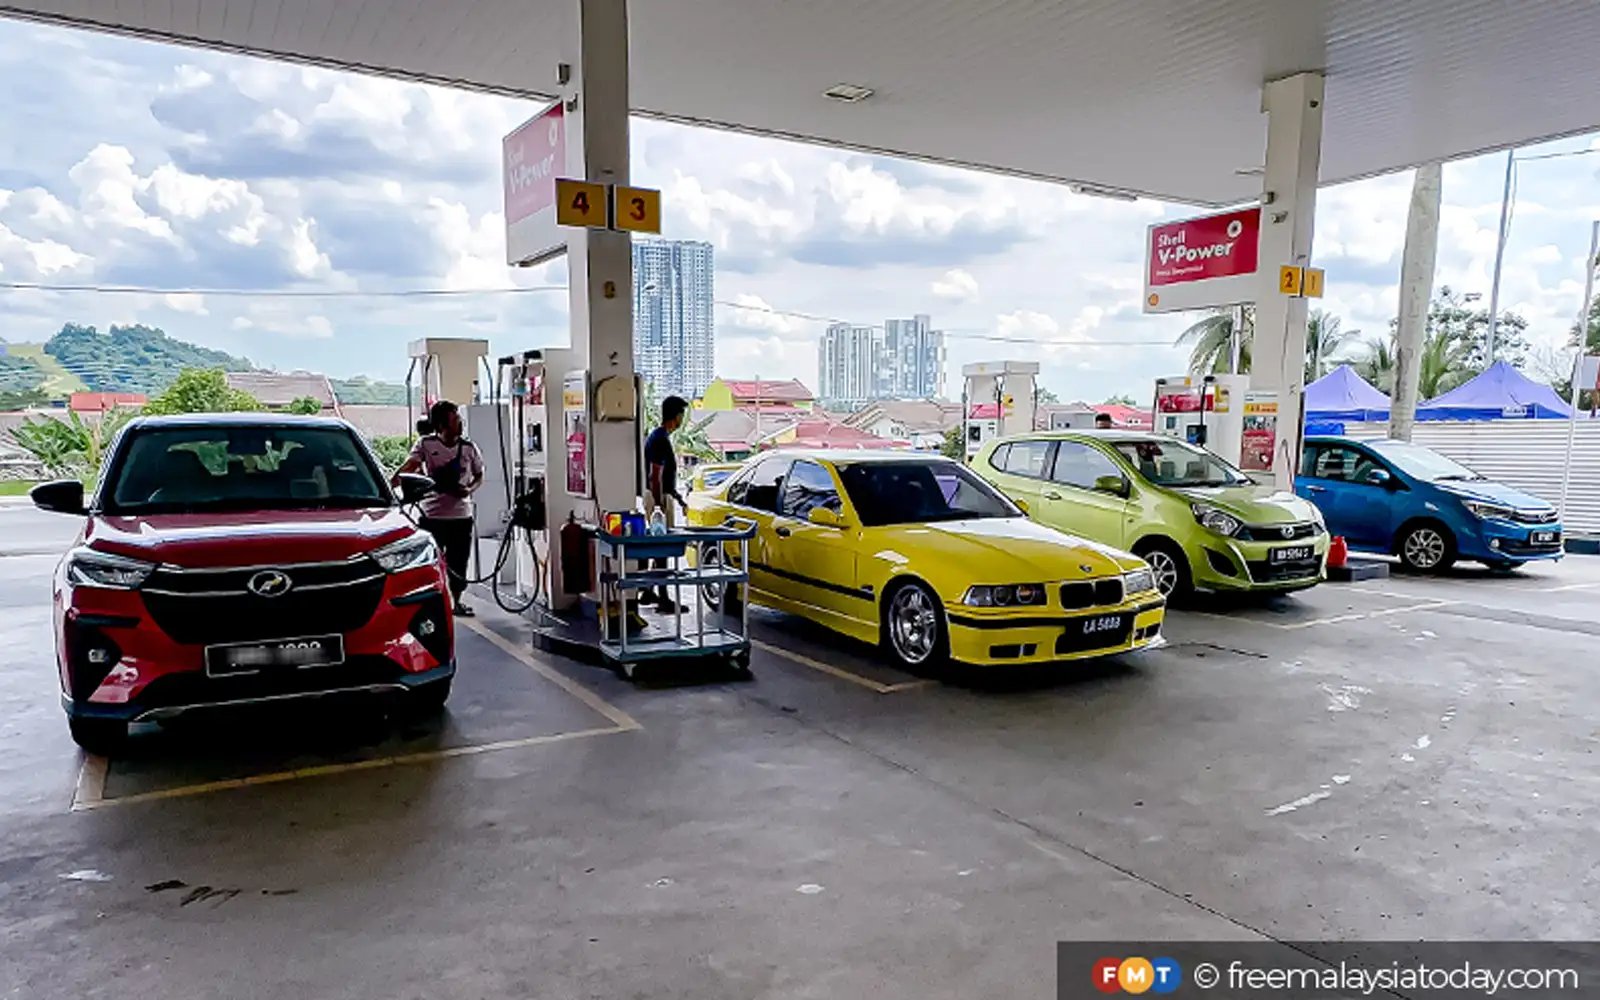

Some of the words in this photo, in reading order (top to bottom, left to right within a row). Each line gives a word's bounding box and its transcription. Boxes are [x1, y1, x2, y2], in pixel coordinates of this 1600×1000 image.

[571, 191, 590, 216] 4
[629, 198, 646, 221] 3
[1157, 230, 1187, 248] Shell
[1157, 241, 1235, 266] V-Power
[1284, 271, 1294, 289] 2
